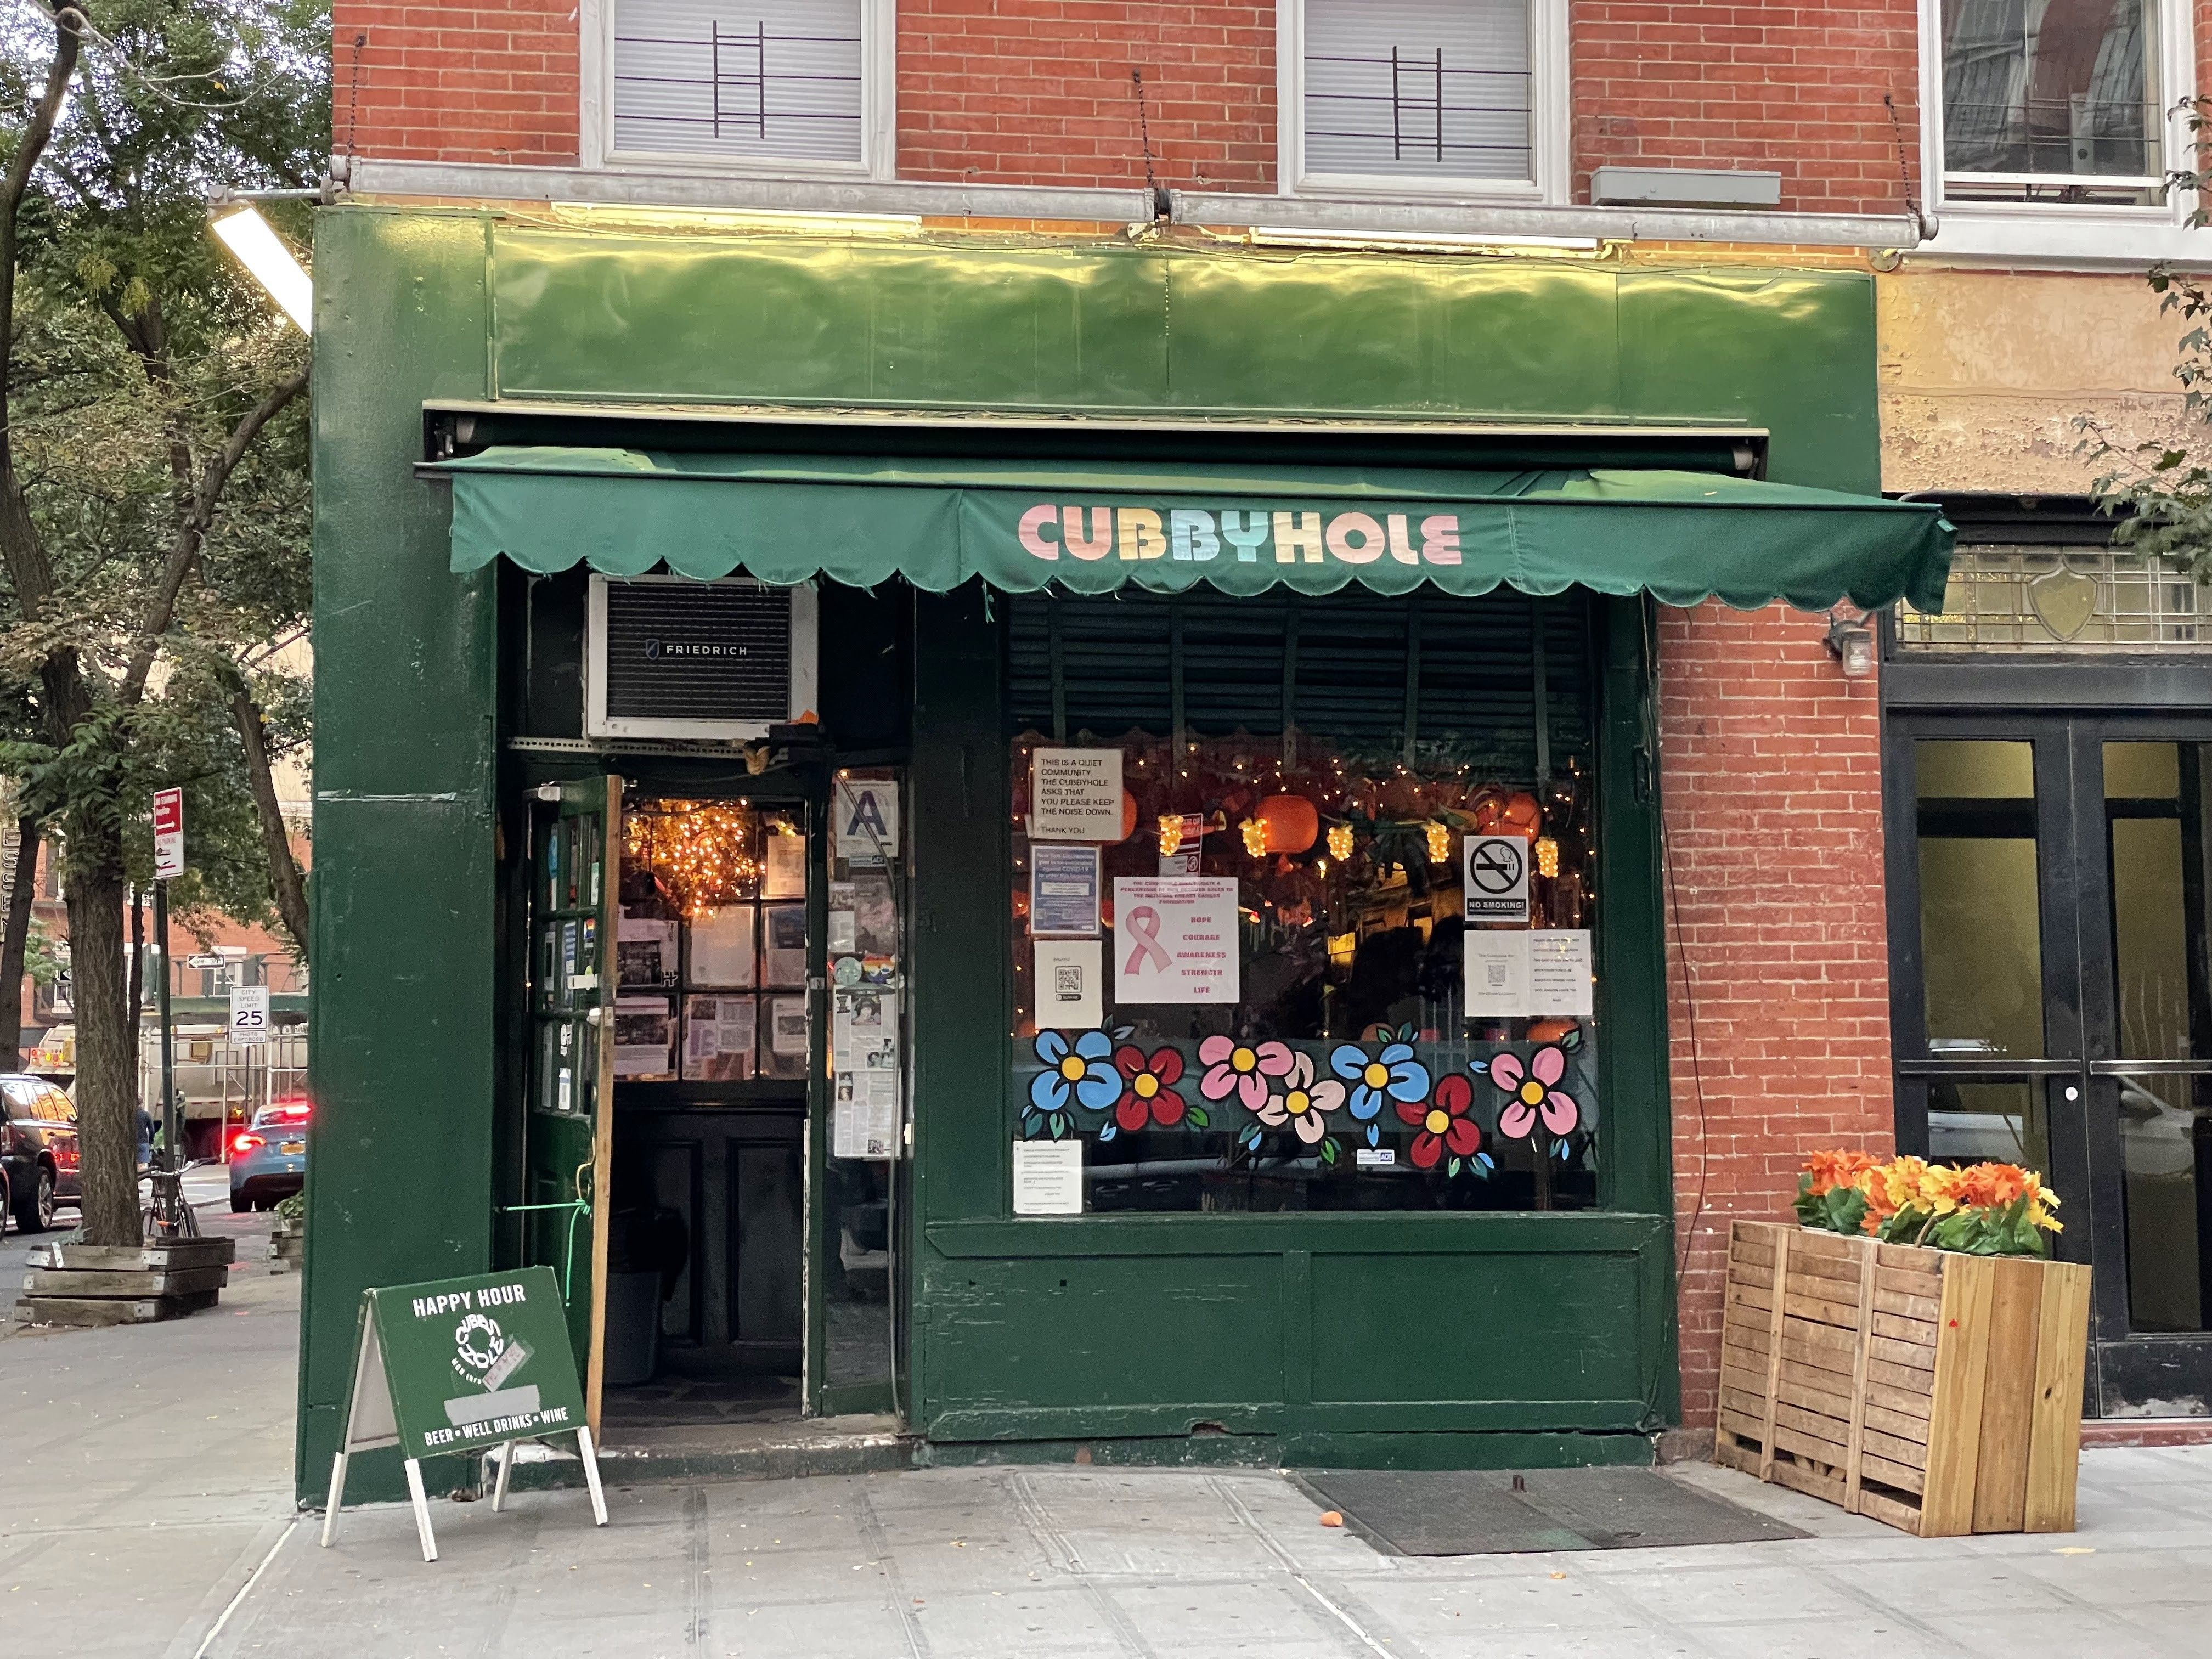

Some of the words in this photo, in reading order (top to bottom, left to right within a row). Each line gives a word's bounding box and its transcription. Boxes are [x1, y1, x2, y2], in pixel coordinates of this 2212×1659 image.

[1018, 504, 1462, 565] CUBBYHOLE
[667, 645, 747, 655] FRIEDRICH
[847, 790, 887, 836] A
[236, 1011, 262, 1025] 25
[413, 1291, 471, 1317] HAPPY
[477, 1284, 526, 1307] HOUR
[424, 1429, 454, 1446] BEER
[462, 1421, 492, 1439] WELL
[493, 1413, 533, 1433] DRINKS
[540, 1407, 569, 1424] WINE
